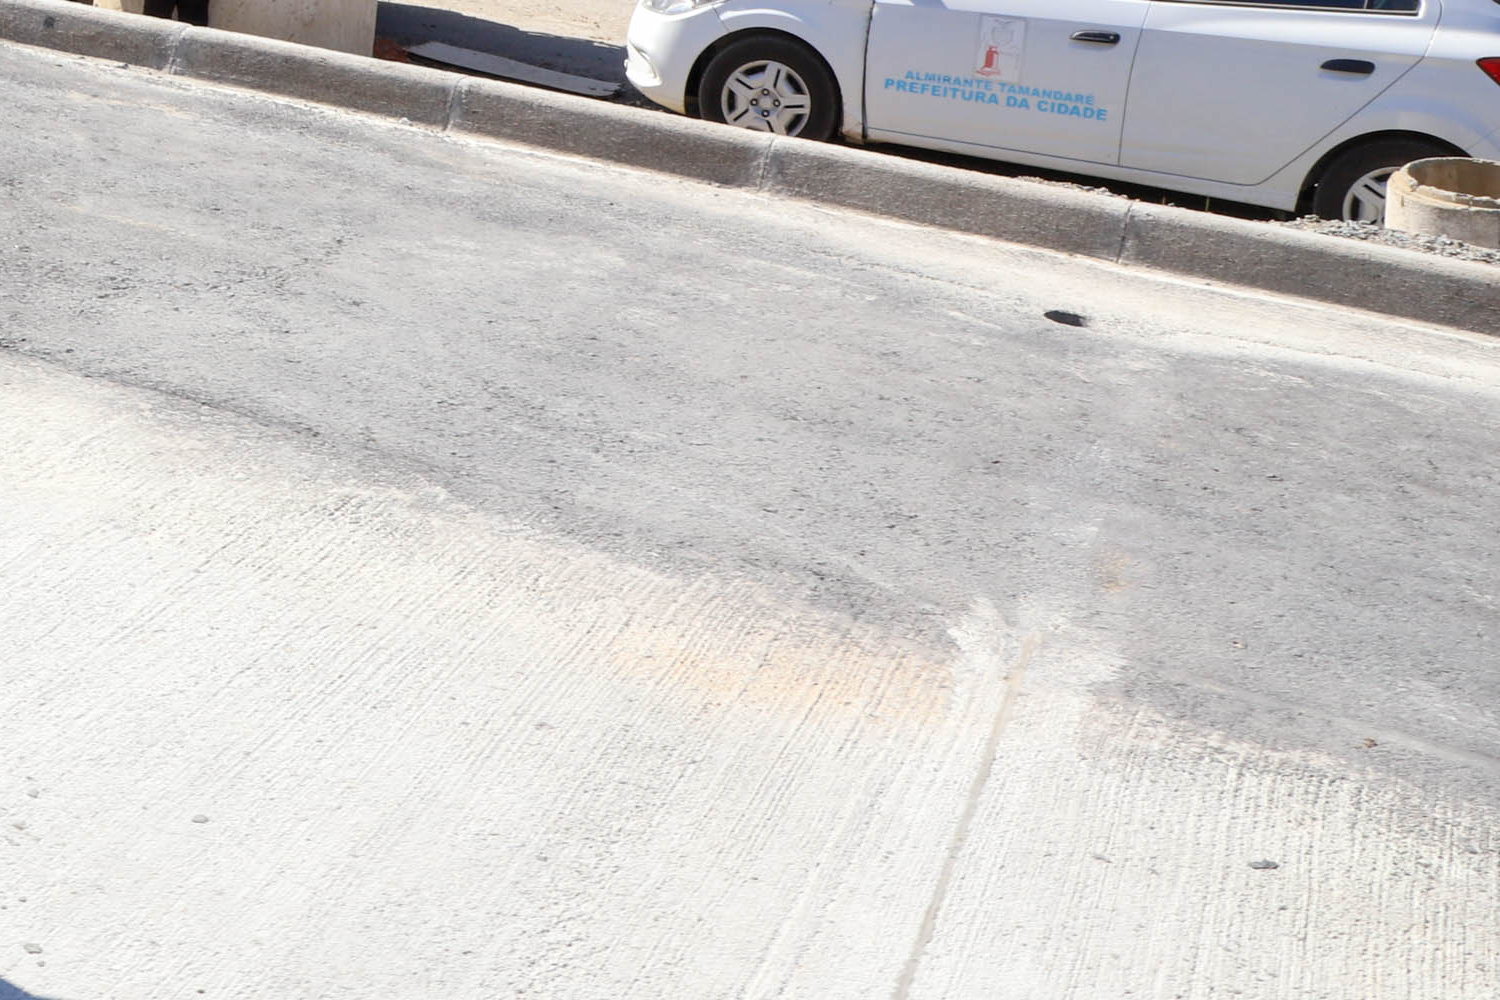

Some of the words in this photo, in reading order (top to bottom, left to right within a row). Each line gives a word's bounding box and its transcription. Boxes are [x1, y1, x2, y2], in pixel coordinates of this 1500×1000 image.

[884, 78, 999, 105] PREFEITURA
[1005, 94, 1030, 110] DA
[1037, 99, 1108, 122] CIDADE
[904, 70, 994, 91] ALMIRANTE
[999, 81, 1095, 106] TAMANDARÉ
